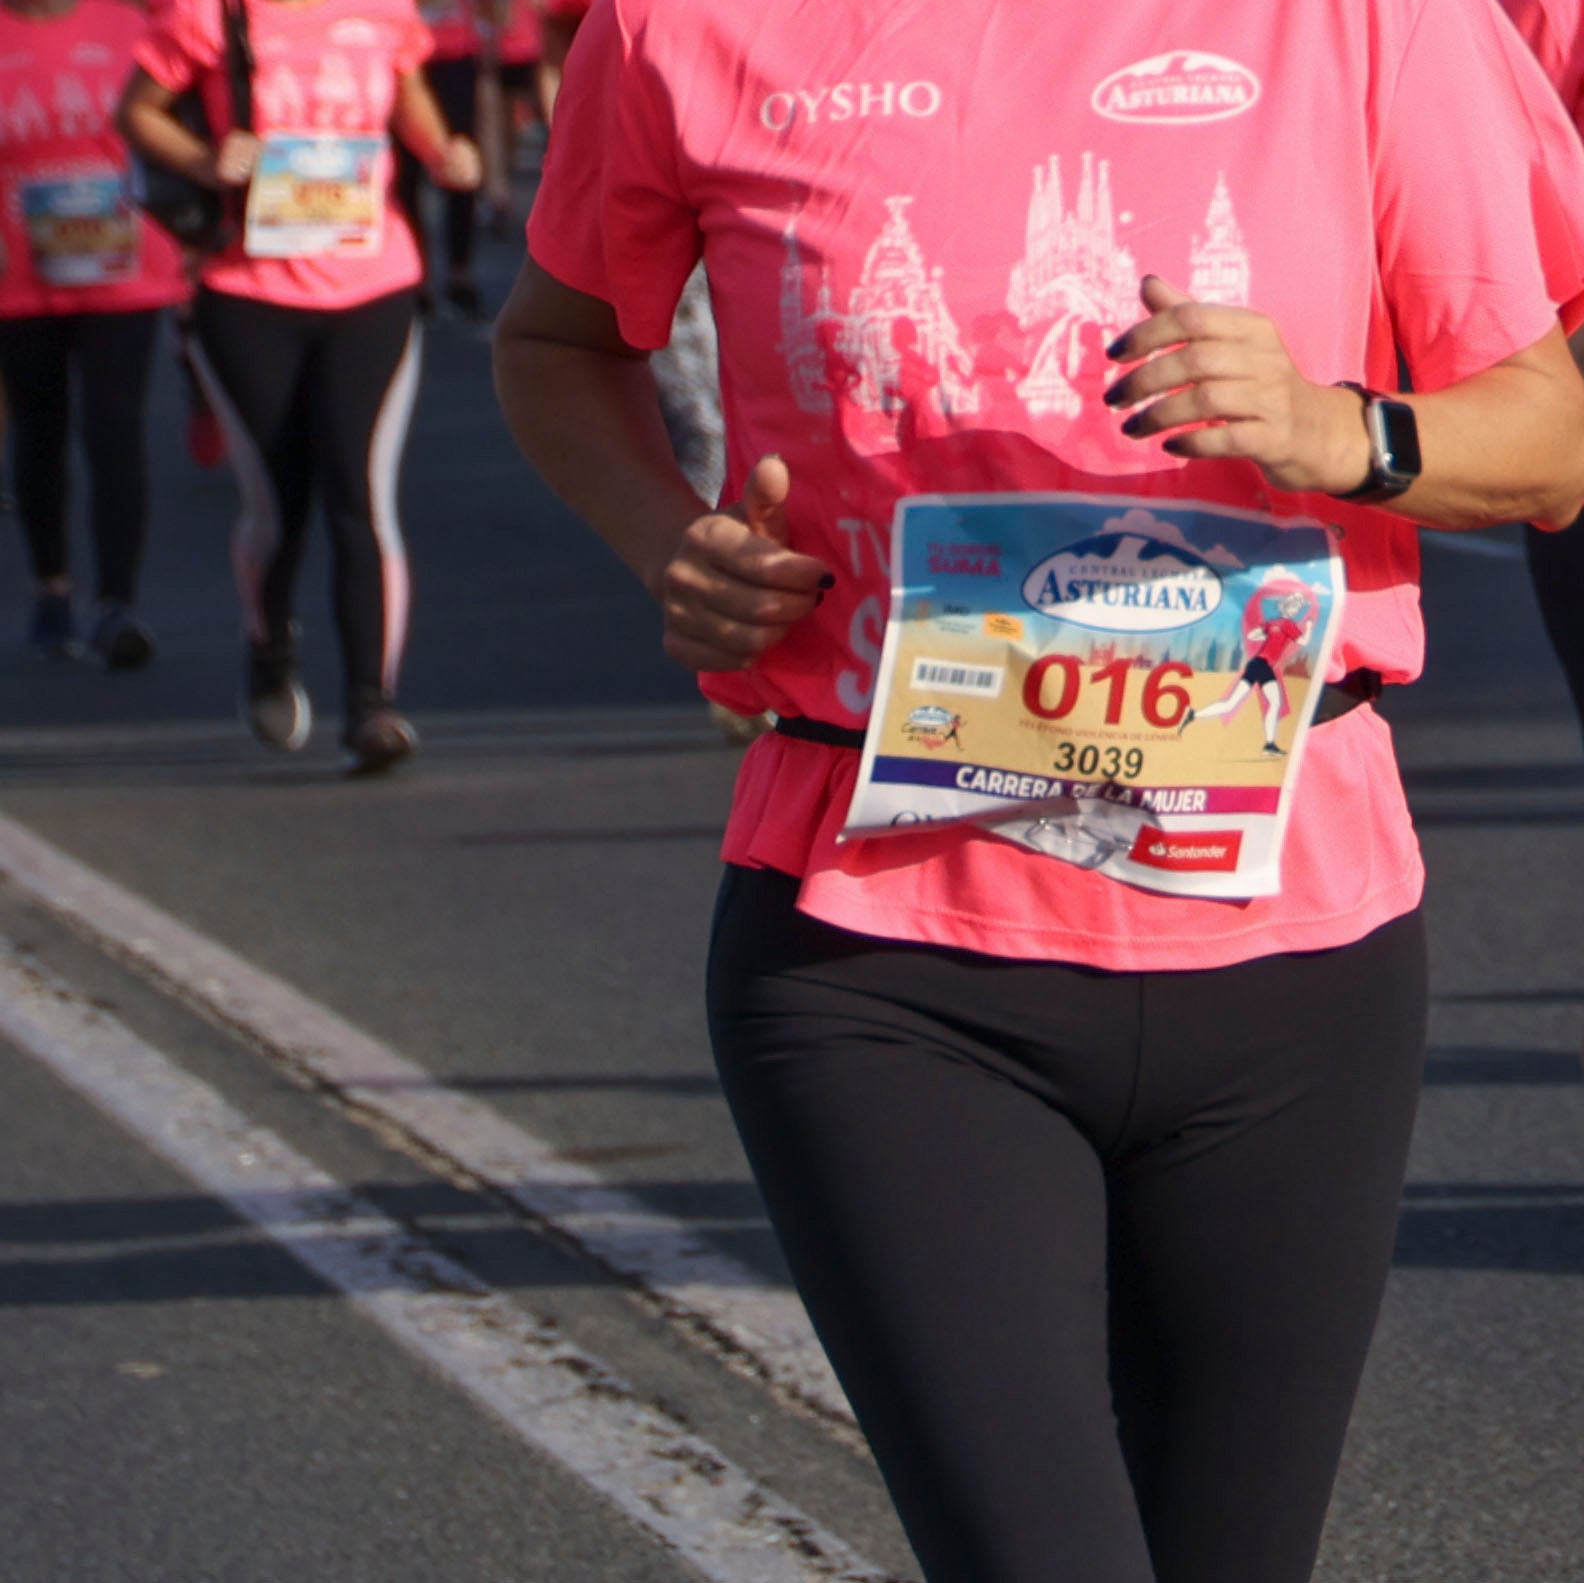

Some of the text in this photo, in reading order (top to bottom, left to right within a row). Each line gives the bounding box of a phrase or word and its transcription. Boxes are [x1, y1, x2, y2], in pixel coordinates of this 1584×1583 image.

[759, 81, 942, 131] OYSHO
[1104, 84, 1248, 113] ASTURIANA
[1036, 569, 1210, 612] ASTURIANA
[1021, 652, 1195, 729] 016
[1052, 741, 1145, 780] 3039
[954, 765, 1208, 813] CARRERA DE LA MUJER
[1164, 843, 1227, 860] Santander
